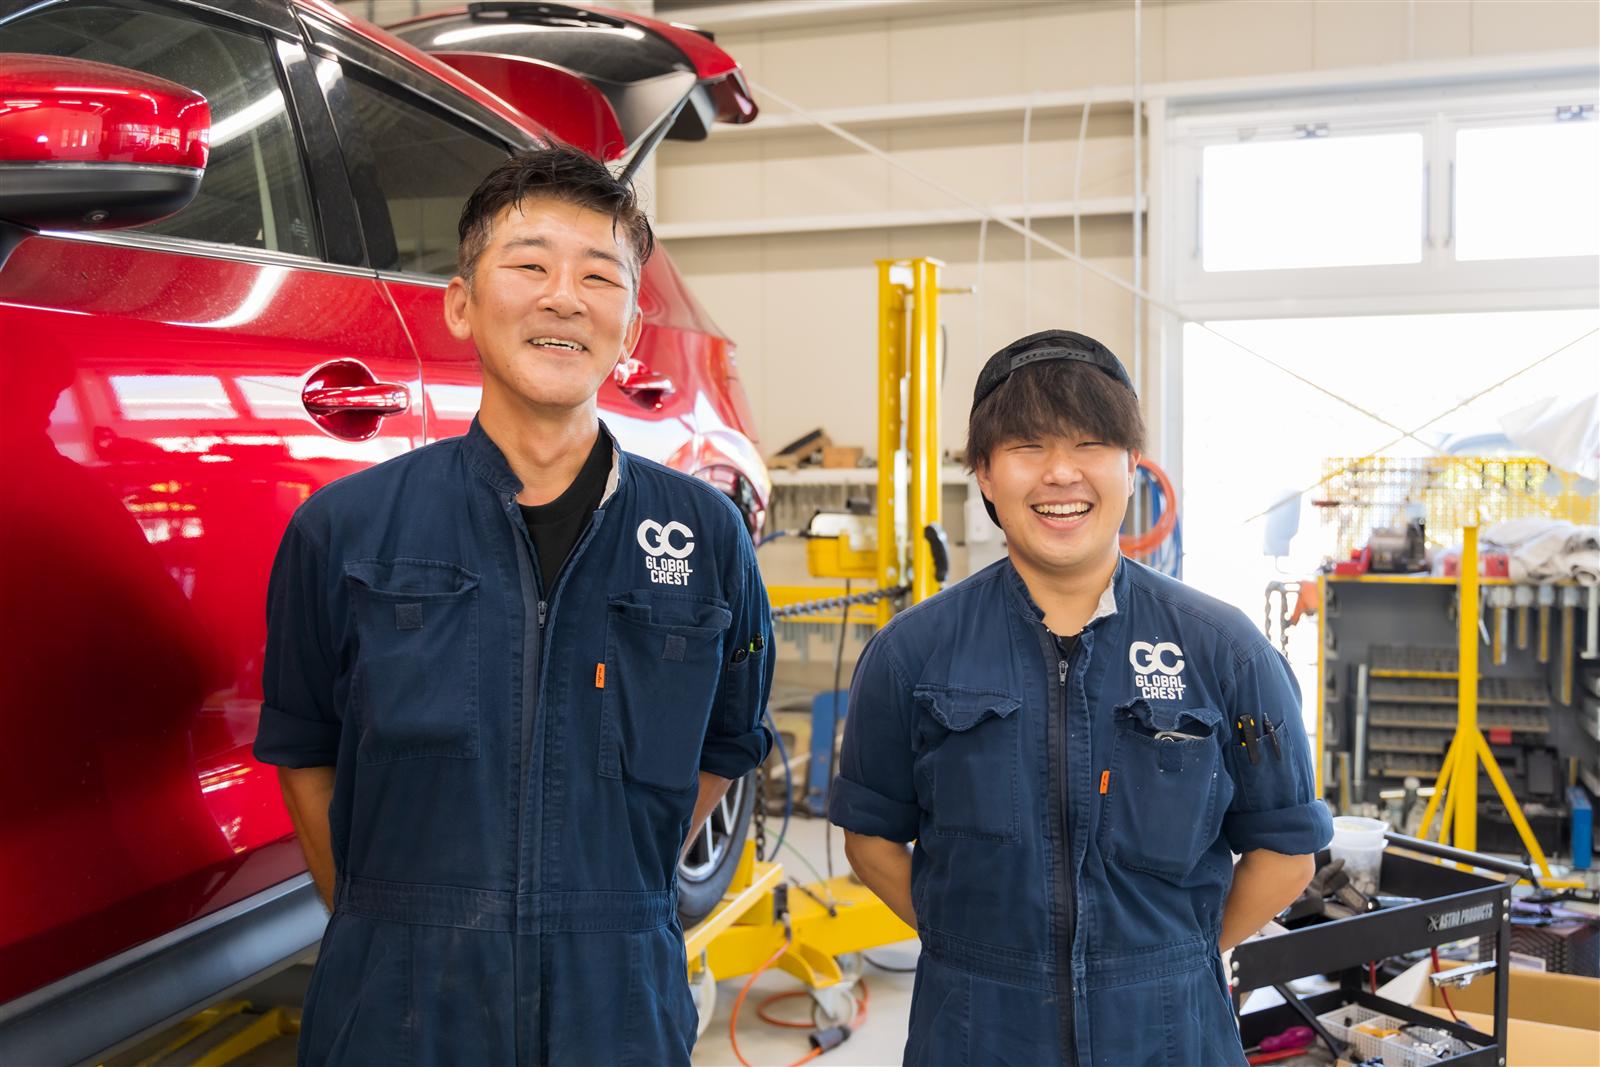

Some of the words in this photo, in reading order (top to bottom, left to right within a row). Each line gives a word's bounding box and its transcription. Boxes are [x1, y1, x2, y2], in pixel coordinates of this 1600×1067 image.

[637, 519, 695, 559] GC
[645, 556, 693, 573] GLOBAL
[650, 570, 690, 586] CREST
[1129, 641, 1185, 675] GC
[1135, 675, 1187, 688] GLOBAL
[1142, 687, 1184, 700] CREST
[1460, 902, 1494, 925] PRODUCTS
